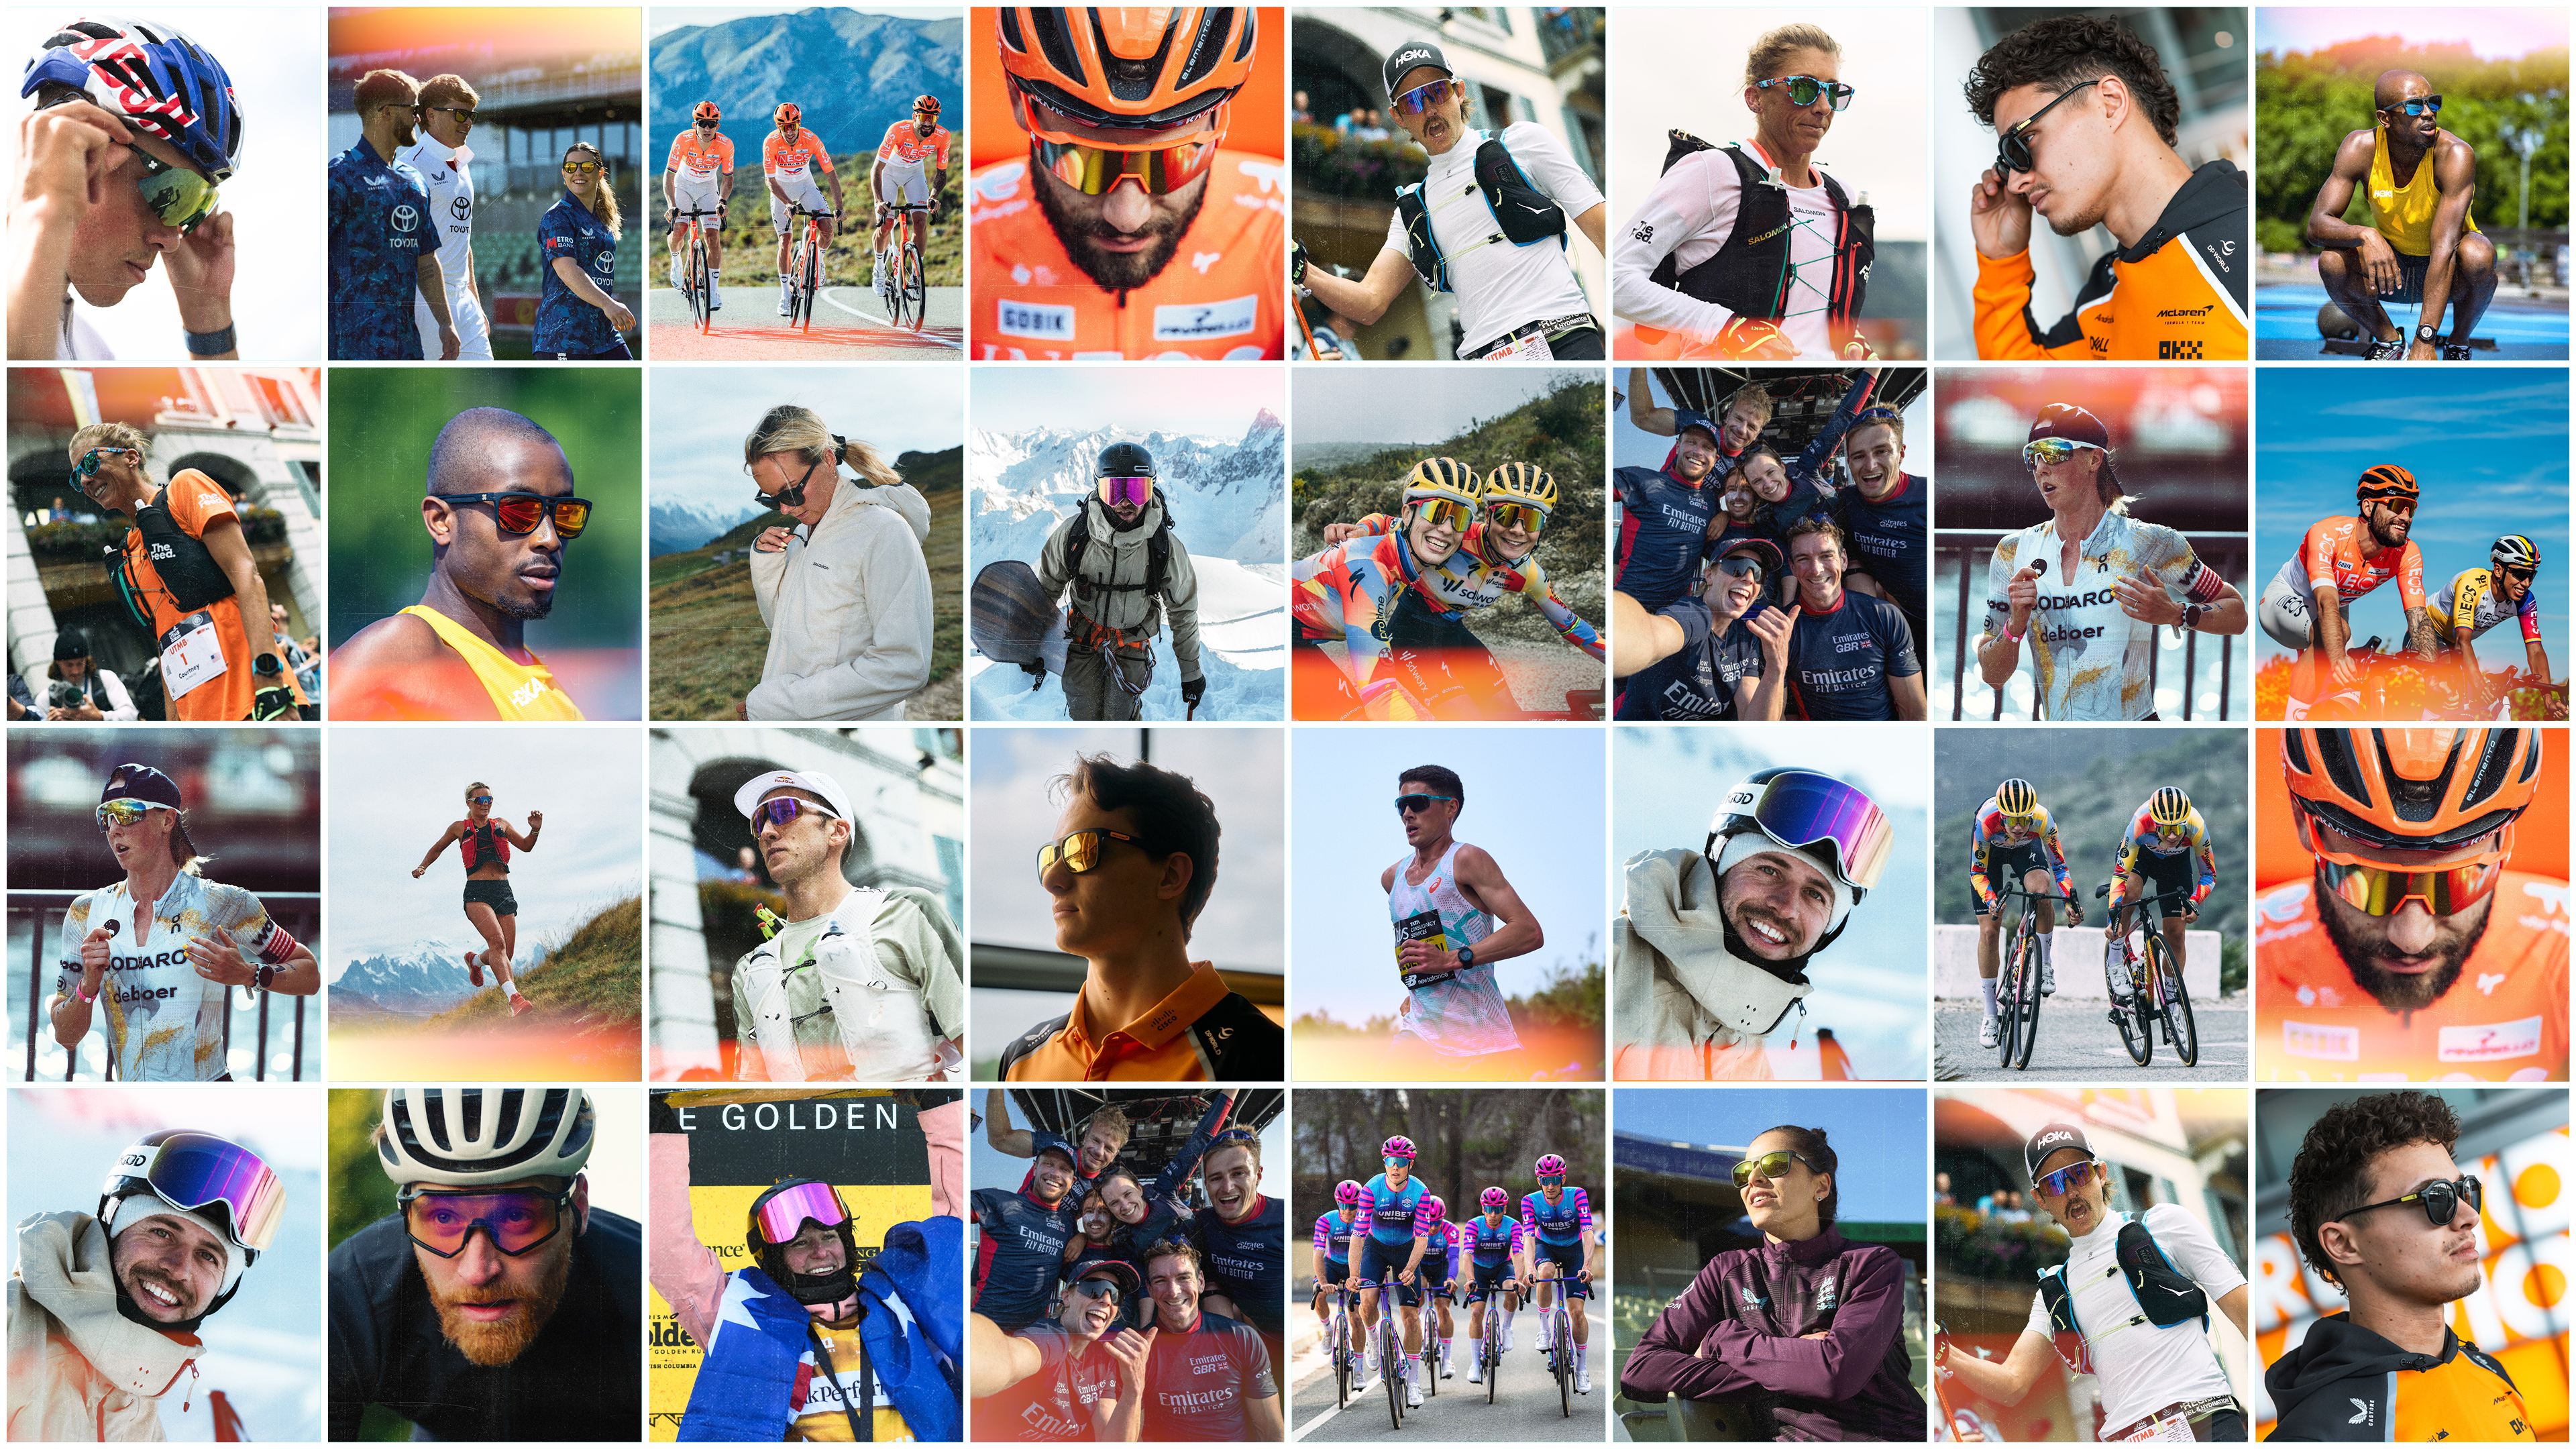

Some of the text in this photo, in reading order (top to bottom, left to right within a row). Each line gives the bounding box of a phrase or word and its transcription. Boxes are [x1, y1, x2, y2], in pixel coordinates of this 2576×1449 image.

[1396, 49, 1432, 69] HOKA
[816, 140, 830, 164] INEOS
[880, 131, 896, 157] INEOS
[899, 146, 935, 157] INEOS
[686, 156, 721, 166] INEOS
[777, 154, 810, 163] INEOS
[1793, 207, 1826, 217] SALOMON
[450, 225, 470, 233] TOYOT
[1748, 222, 1788, 246] SALOMON
[390, 238, 419, 248] TOYOTA
[2207, 244, 2230, 273] DP WORLD
[1292, 259, 1305, 282] EKI
[592, 276, 614, 286] TOYOT
[2156, 309, 2206, 318] McLaren
[1559, 317, 1588, 330] HYDRATION
[2090, 335, 2110, 353] DELL
[1689, 500, 1702, 508] GBR
[1662, 503, 1707, 527] Emirates
[1667, 517, 1702, 535] FLY BETTER
[151, 543, 170, 553] The
[1854, 531, 1908, 549] Emirates
[151, 549, 176, 561] Feed.
[1861, 543, 1897, 559] FLY BETTER
[2319, 533, 2336, 577] INEOS
[812, 561, 830, 570] SALOMON
[2338, 561, 2352, 570] GOBIK
[2408, 553, 2424, 596] INEOS
[1459, 588, 1501, 606] sdwor
[2033, 588, 2114, 611] ODARO
[2458, 584, 2477, 622] INEOS
[1292, 602, 1320, 614] worx
[2276, 594, 2309, 617] INEOS
[1377, 596, 1389, 640] protime
[2475, 610, 2508, 623] INEOS
[2528, 599, 2540, 635] INEOS
[1833, 631, 1870, 645] Emirates
[2041, 624, 2106, 643] deboer
[1835, 643, 1859, 653] GBR
[180, 653, 188, 665] 1
[1721, 657, 1750, 673] Emirates
[178, 663, 201, 680] Courtney
[1699, 665, 1712, 673] carbo
[1722, 669, 1741, 683] GBR
[1801, 665, 1876, 685] Emirates
[1405, 661, 1429, 694] sdworx
[508, 677, 547, 711] HOKA
[1816, 683, 1830, 694] FLY
[2051, 836, 2061, 861] sdworx
[2204, 848, 2212, 870] sdworx
[1410, 920, 1436, 933] CONSULTANCY
[1411, 929, 1428, 938] SERVICES
[105, 949, 187, 971] ODARO
[113, 984, 178, 1004] deboer
[1157, 1015, 1177, 1031] CISCO
[1208, 1036, 1222, 1056] WORLD
[722, 1103, 898, 1131] GOLDEN
[2038, 1131, 2074, 1151] HOKA
[1046, 1222, 1059, 1230] GBR
[1542, 1218, 1576, 1228] UNIBET
[1020, 1225, 1065, 1249] Emirates
[1024, 1239, 1059, 1257] FLY BETTER
[1212, 1252, 1265, 1271] Emirates
[1218, 1265, 1254, 1281] FLY BETTER
[1190, 1353, 1227, 1366] Emirates
[1934, 1341, 1947, 1364] EKI
[1193, 1364, 1216, 1375] GBR
[1057, 1387, 1069, 1395] carbo
[1078, 1379, 1107, 1395] Emirates
[1079, 1391, 1098, 1405] GBR
[1159, 1387, 1234, 1407] Emirates
[1173, 1405, 1187, 1415] FLY
[2201, 1399, 2230, 1412] HYDRATION
